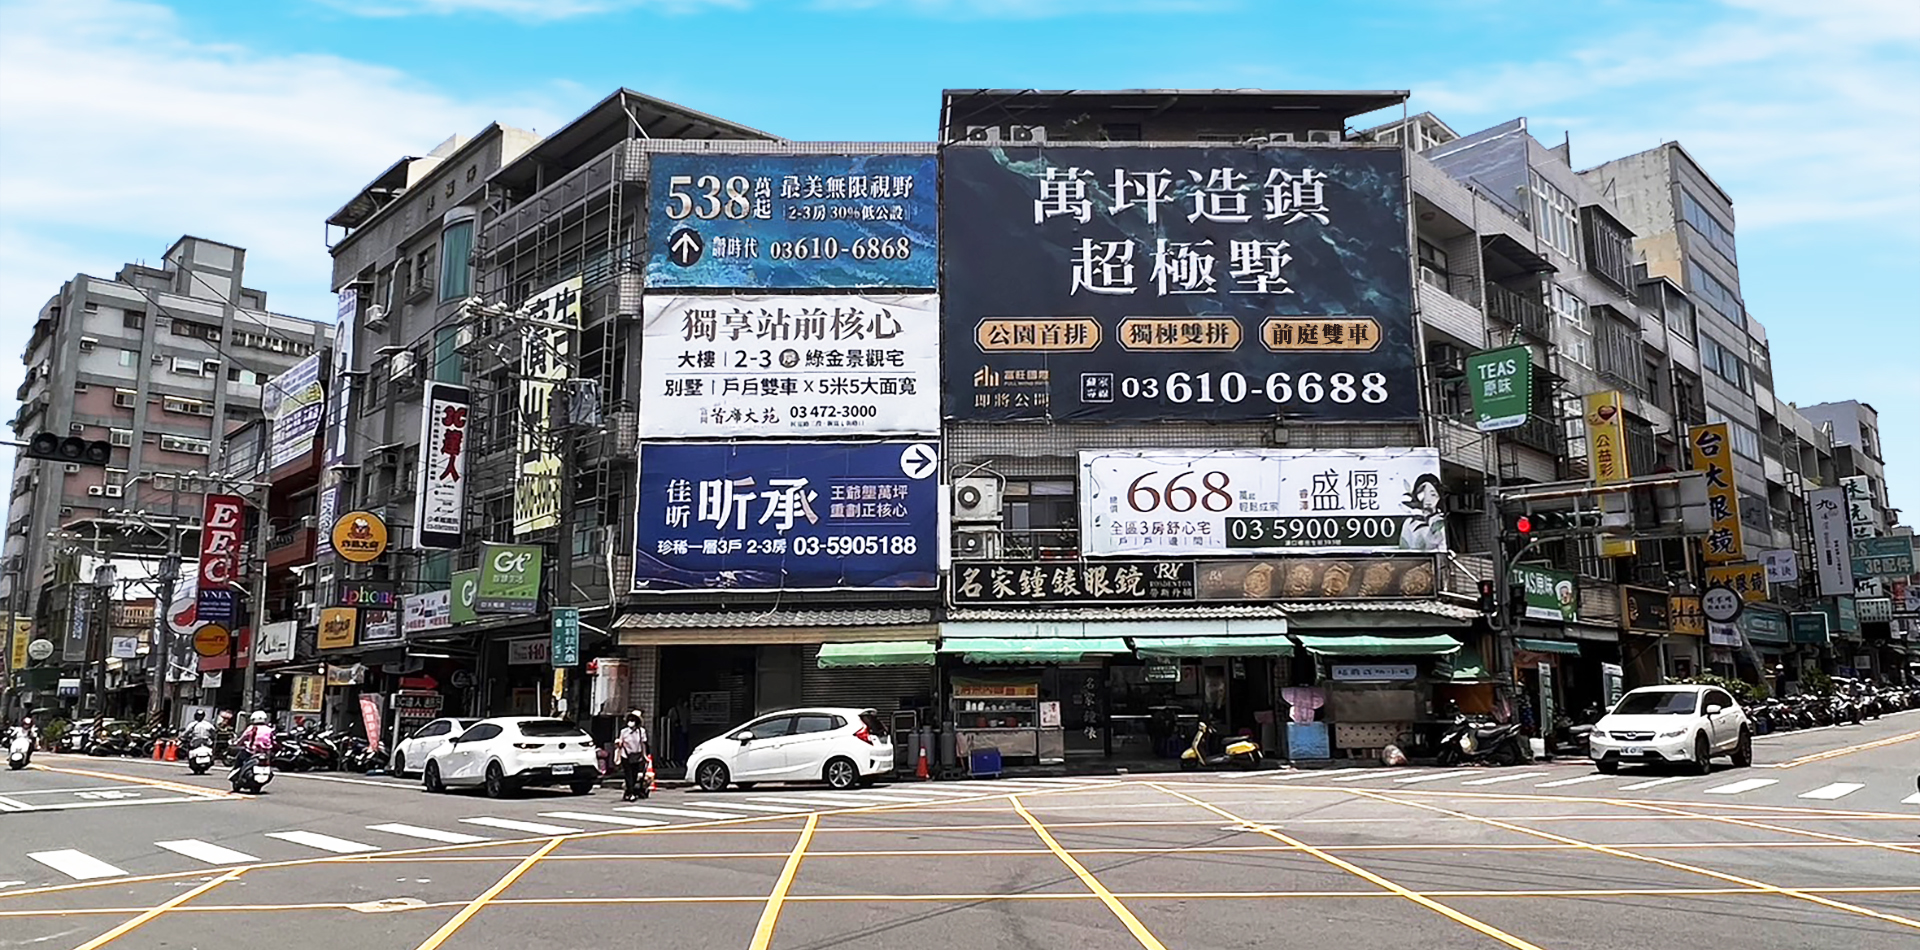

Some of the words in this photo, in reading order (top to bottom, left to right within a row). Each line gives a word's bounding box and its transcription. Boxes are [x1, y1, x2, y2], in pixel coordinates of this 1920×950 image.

[665, 175, 750, 220] 538
[753, 177, 772, 219] 萬起
[780, 175, 913, 199] 最美無限視野
[1033, 167, 1330, 226] 萬坪造鎮
[789, 205, 825, 221] 2-3房
[831, 205, 903, 221] 30%低公設
[1069, 238, 1295, 297] 超極墅
[681, 308, 904, 342] 獨享站前核心
[988, 322, 1088, 345] 公園首排
[1129, 322, 1230, 345] 獨棟雙拼
[1272, 322, 1370, 345] 前庭雙車
[677, 350, 716, 368] 大樓
[734, 351, 772, 367] 2-3
[805, 350, 905, 368] 綠金景觀宅
[1477, 359, 1516, 380] TEAS
[664, 378, 703, 396] 別墅
[722, 377, 798, 396] 戶戶雙車
[818, 377, 917, 396] 5米5大面寬
[1484, 378, 1513, 397] 原味
[1126, 470, 1233, 513] 668
[1311, 468, 1380, 512] 盛儷
[1696, 430, 1738, 554] 台大眼鏡
[665, 478, 692, 529] 佳昕
[698, 476, 818, 531] 昕承
[830, 503, 908, 518] 重劃正核心
[1109, 521, 1211, 536] 全區3房舒心宅
[657, 539, 741, 554] 珍稀一層3戶
[747, 539, 787, 554] 2-3房
[793, 535, 917, 555] 03-5905188
[957, 565, 1147, 599] 名家鐘錶眼鏡
